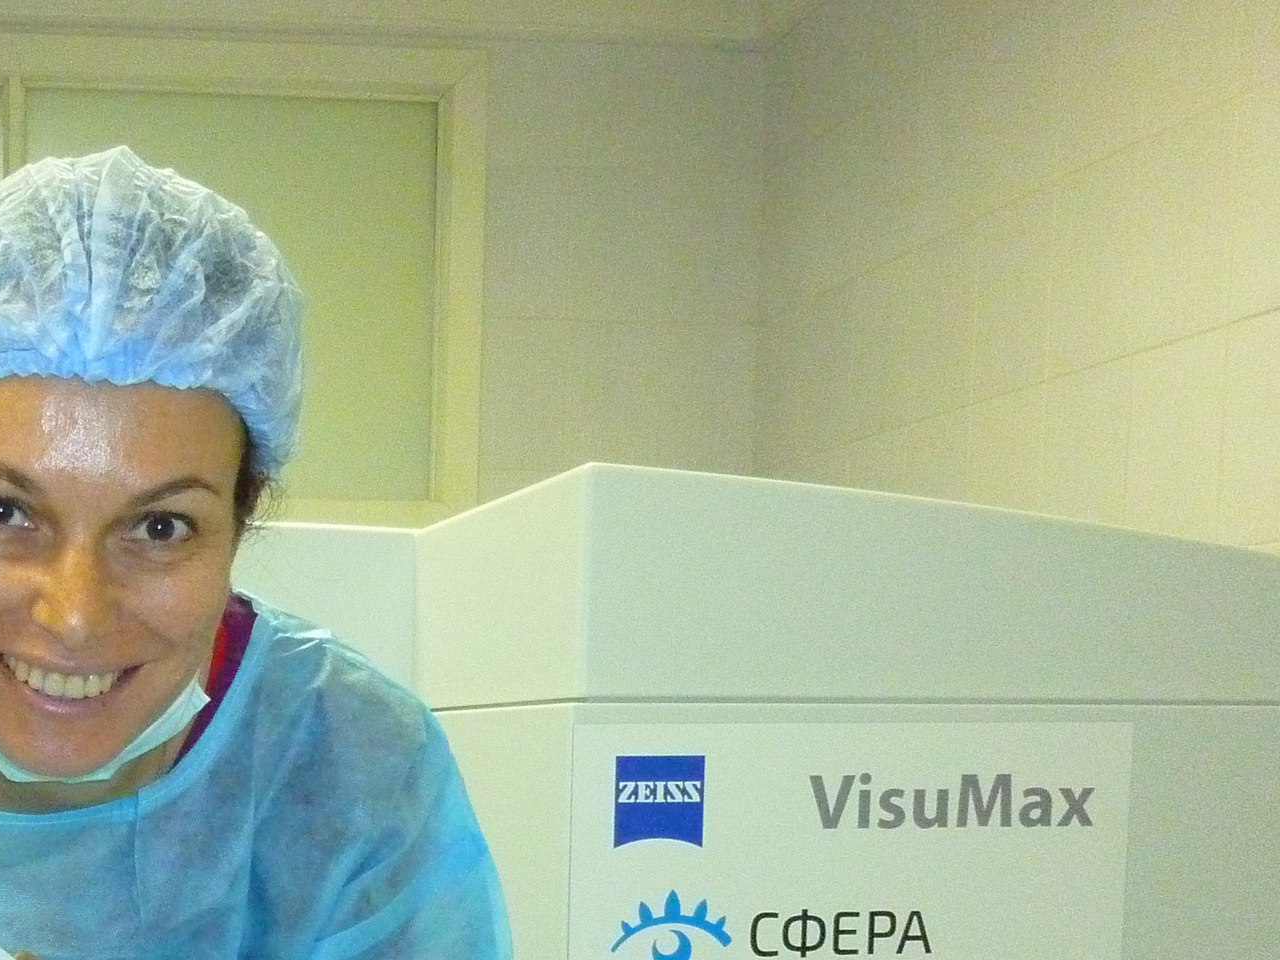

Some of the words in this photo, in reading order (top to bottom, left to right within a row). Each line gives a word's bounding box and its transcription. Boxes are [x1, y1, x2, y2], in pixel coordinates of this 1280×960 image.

[618, 780, 701, 803] ZEISS
[809, 772, 1095, 829] VisuMax
[749, 909, 932, 958] СФЕРА
